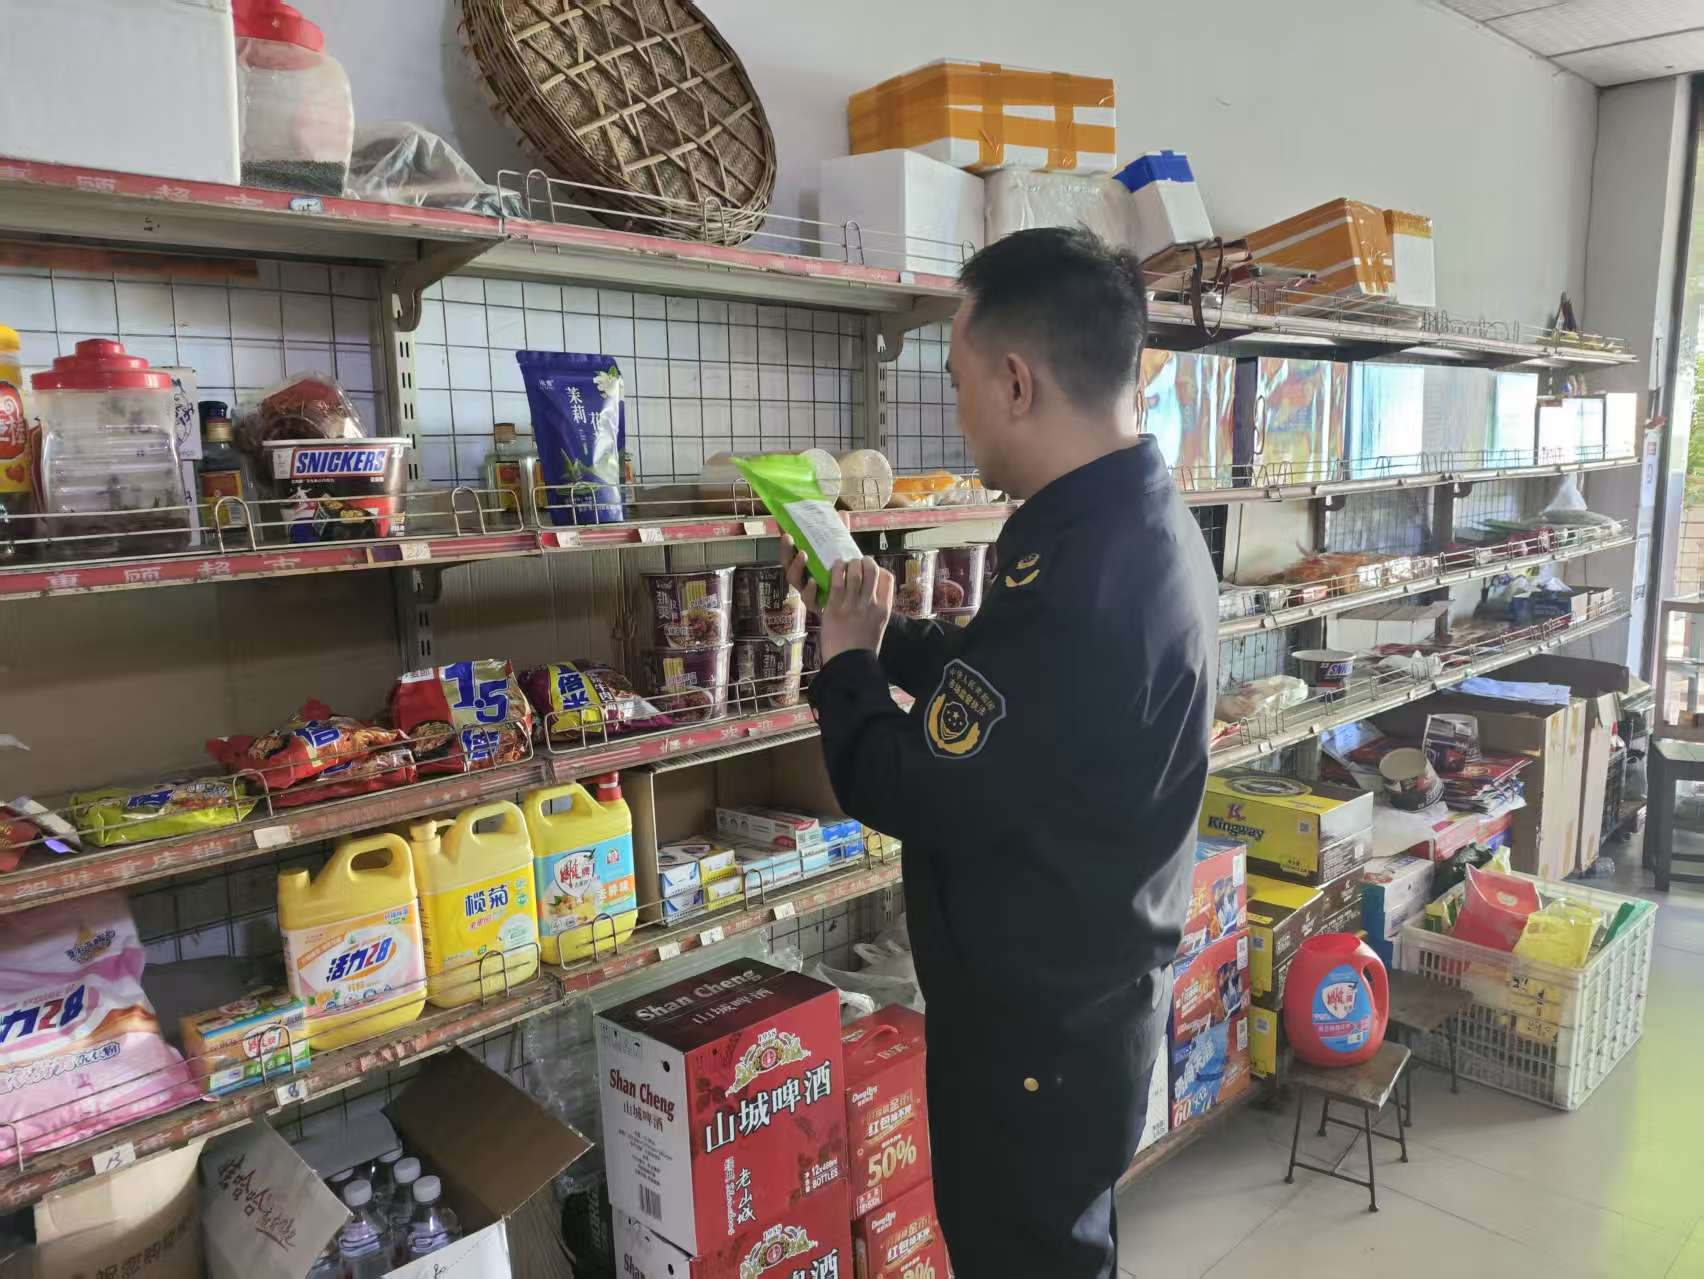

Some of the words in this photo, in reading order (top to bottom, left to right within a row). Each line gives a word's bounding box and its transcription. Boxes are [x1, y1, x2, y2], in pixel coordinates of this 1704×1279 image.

[297, 450, 385, 474] SNICKERS
[1207, 815, 1264, 840] Kingway
[326, 937, 392, 982] 活力28
[635, 994, 693, 1021] Shan
[693, 969, 763, 998] Cheng
[609, 1068, 637, 1099] Shan
[639, 1083, 675, 1123] Cheng
[705, 1060, 832, 1153] 山城啤酒
[812, 1167, 838, 1189] BOTTLES
[867, 1135, 917, 1187] 50%
